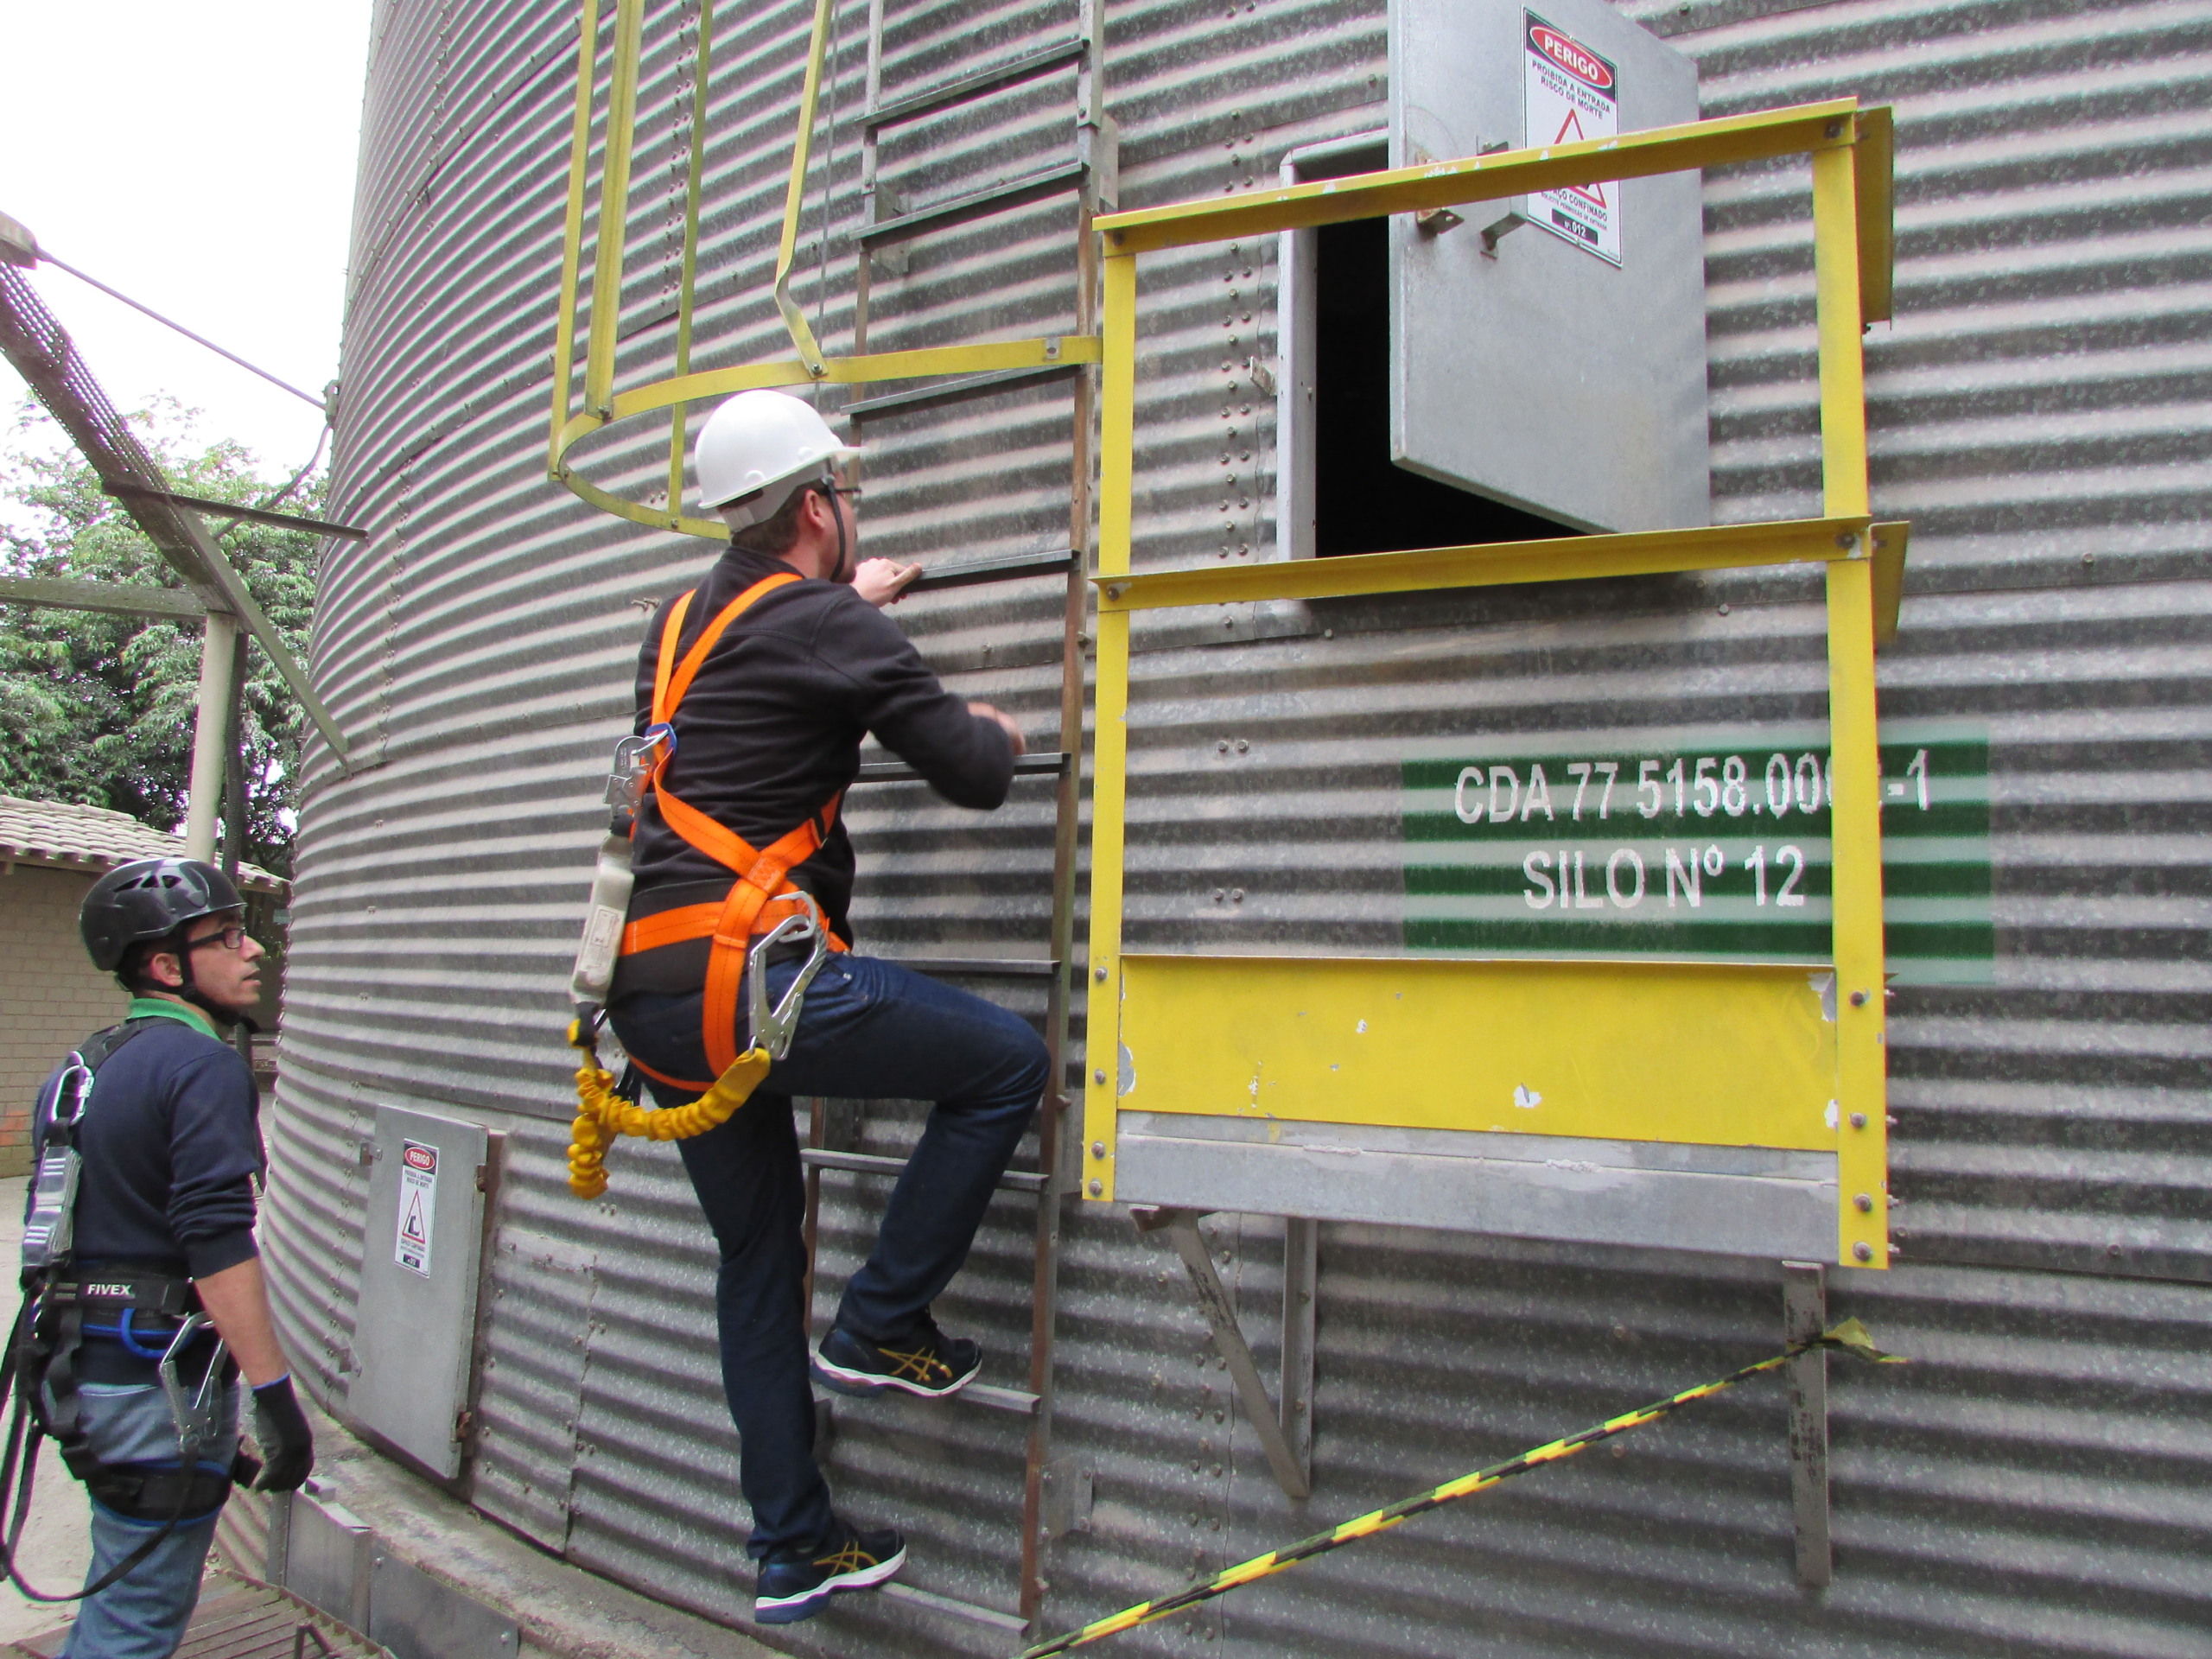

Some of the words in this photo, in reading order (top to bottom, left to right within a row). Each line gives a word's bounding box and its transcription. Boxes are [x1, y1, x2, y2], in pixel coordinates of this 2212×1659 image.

[1544, 34, 1599, 80] PERIGO
[1532, 60, 1567, 88] PROIBIDA
[1570, 83, 1575, 92] A
[1577, 87, 1611, 114] ENTRADA
[1541, 76, 1564, 97] RISCO
[1566, 91, 1576, 102] DE
[1578, 99, 1603, 119] MORTE
[1568, 194, 1608, 222] CONFINADO
[1572, 221, 1586, 238] 012
[1454, 763, 1554, 823] CDA
[1567, 761, 1619, 821] 77
[1636, 749, 1930, 819] 5158.00-1
[1522, 848, 1645, 909] SILO
[1665, 844, 1724, 907] Nº
[1744, 844, 1806, 906] 12
[410, 1150, 430, 1166] PERIGO
[87, 1284, 132, 1295] FIVEX
